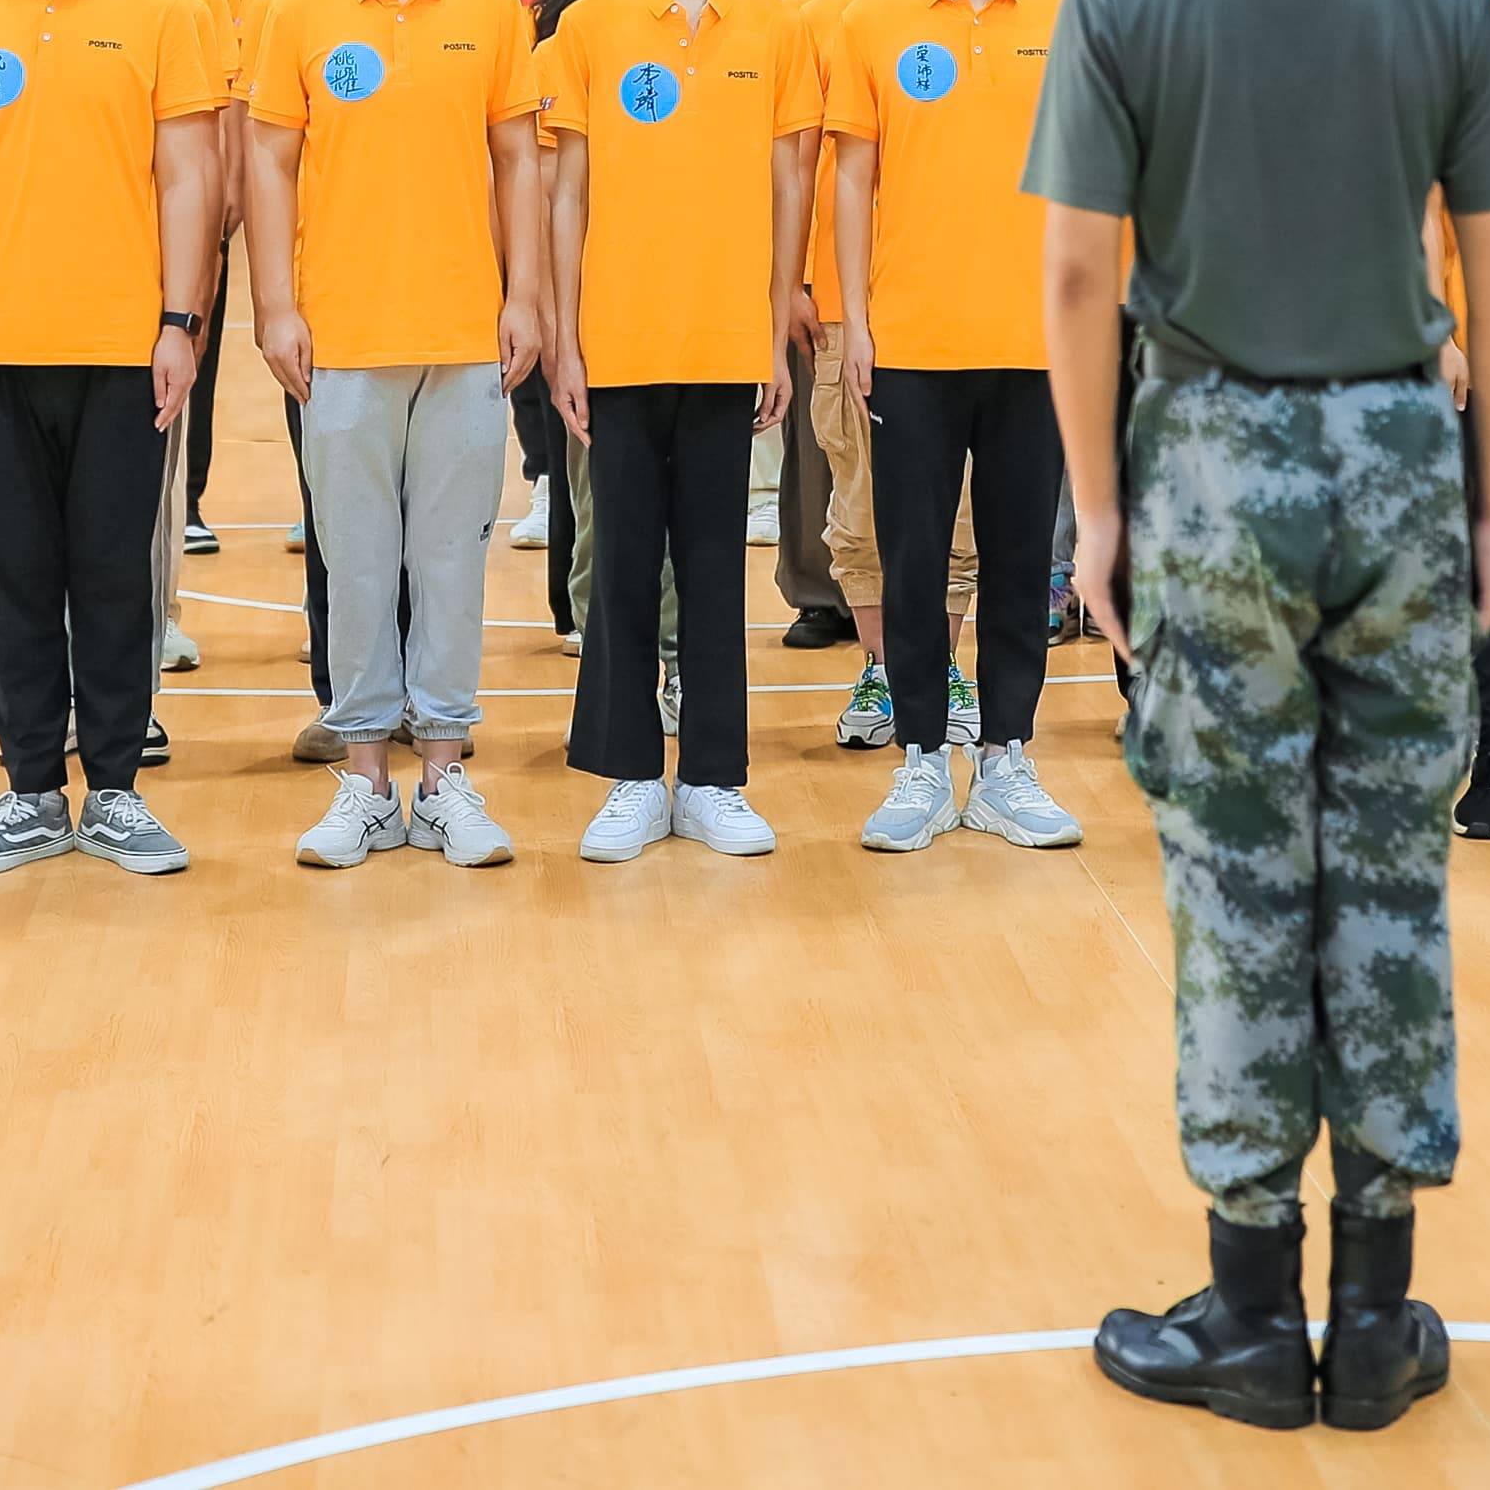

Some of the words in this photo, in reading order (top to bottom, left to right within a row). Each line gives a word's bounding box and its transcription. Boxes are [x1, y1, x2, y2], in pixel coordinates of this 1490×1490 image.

[87, 39, 123, 50] POSITEC
[442, 42, 477, 51] POSITEC
[727, 70, 759, 79] POSITEC
